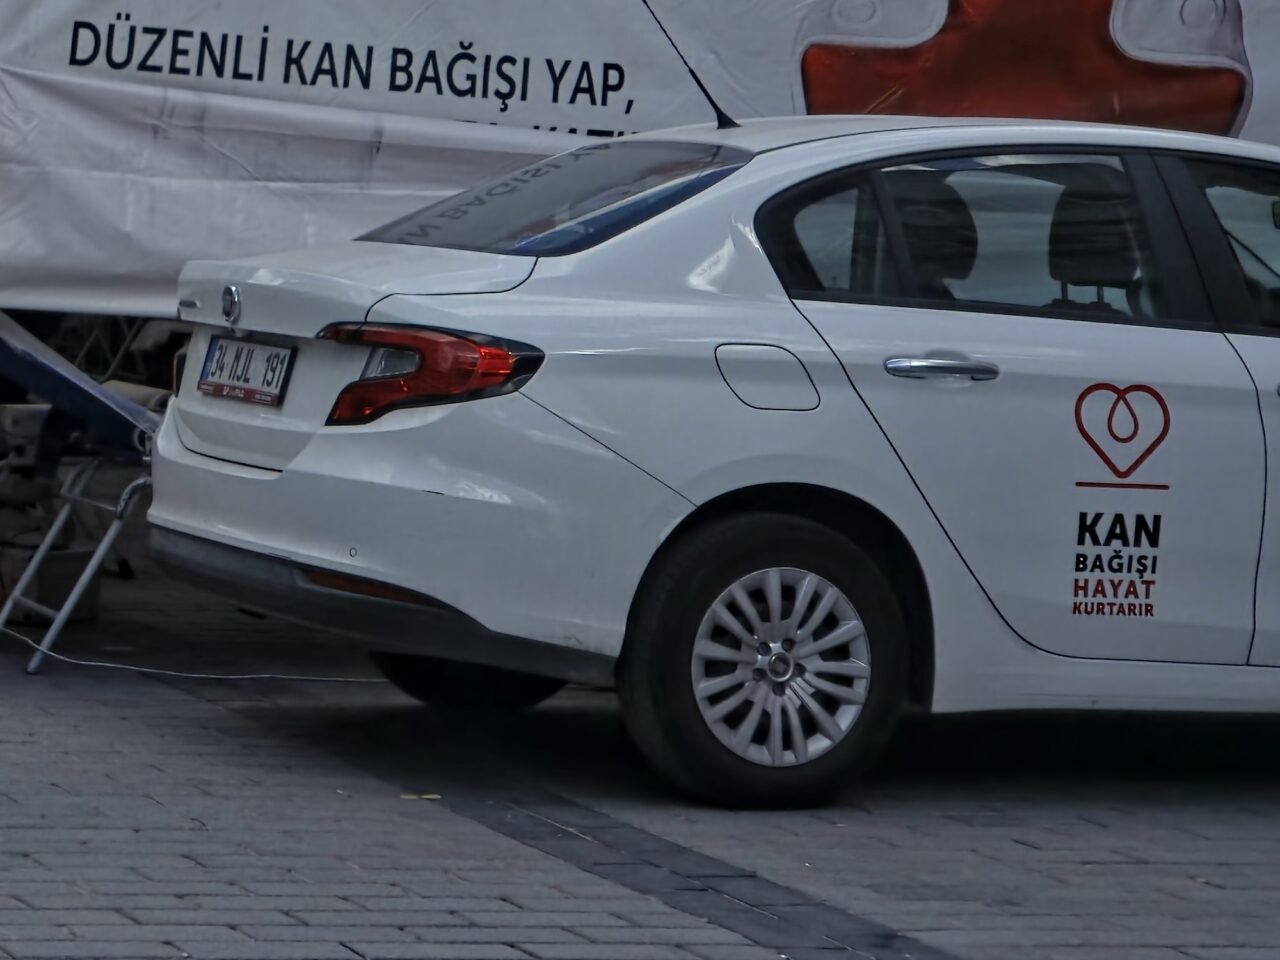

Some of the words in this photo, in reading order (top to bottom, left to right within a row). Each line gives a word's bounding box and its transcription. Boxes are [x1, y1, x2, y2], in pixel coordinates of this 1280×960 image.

[68, 12, 270, 82] DÜZENLİ
[282, 38, 374, 90] KAN
[388, 41, 530, 113] BAĞIŞI
[544, 57, 634, 114] YAP,
[211, 343, 228, 379] 34
[261, 351, 287, 389] 191
[1076, 511, 1161, 548] KAN
[1075, 549, 1158, 579] BAĞIŞI
[1073, 578, 1156, 600] HAYAT
[1072, 601, 1154, 617] KURTARIR
